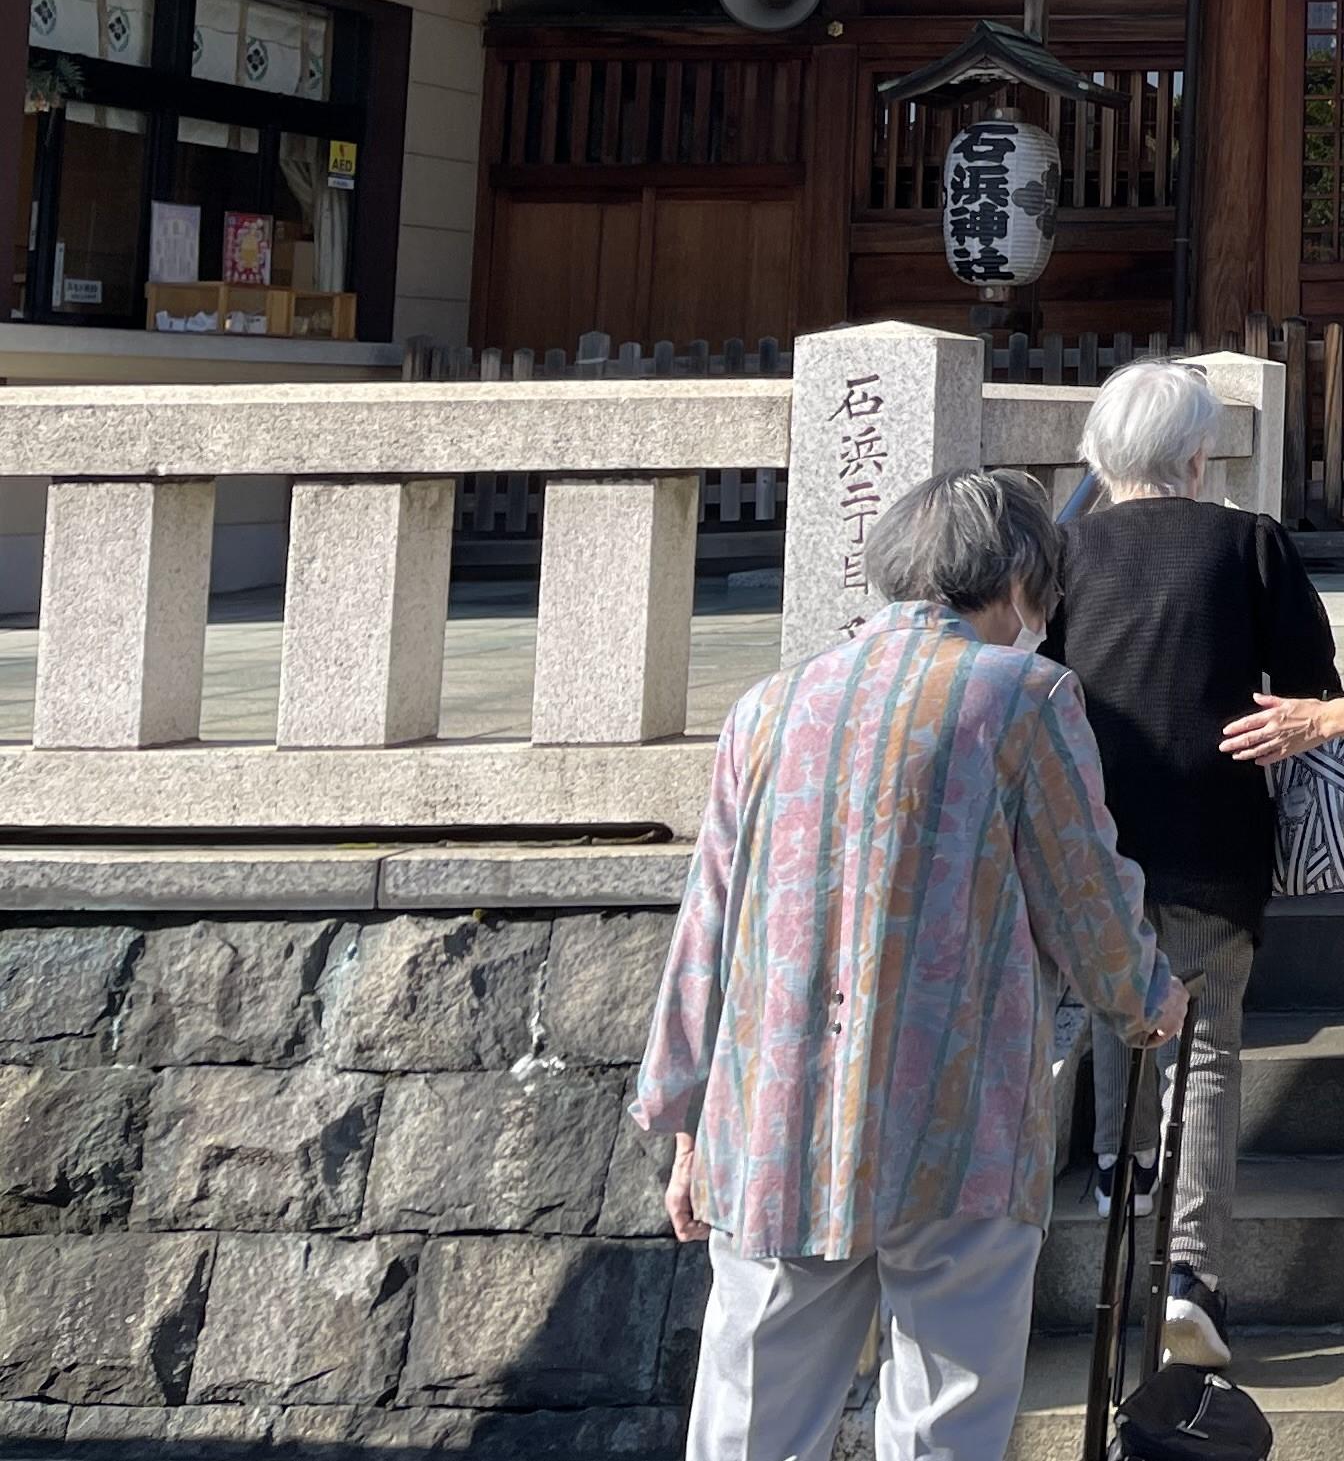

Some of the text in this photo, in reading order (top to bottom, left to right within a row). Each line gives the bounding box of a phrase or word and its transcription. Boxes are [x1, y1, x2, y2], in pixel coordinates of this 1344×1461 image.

[331, 157, 353, 172] AED
[949, 123, 1019, 282] 石浜神社
